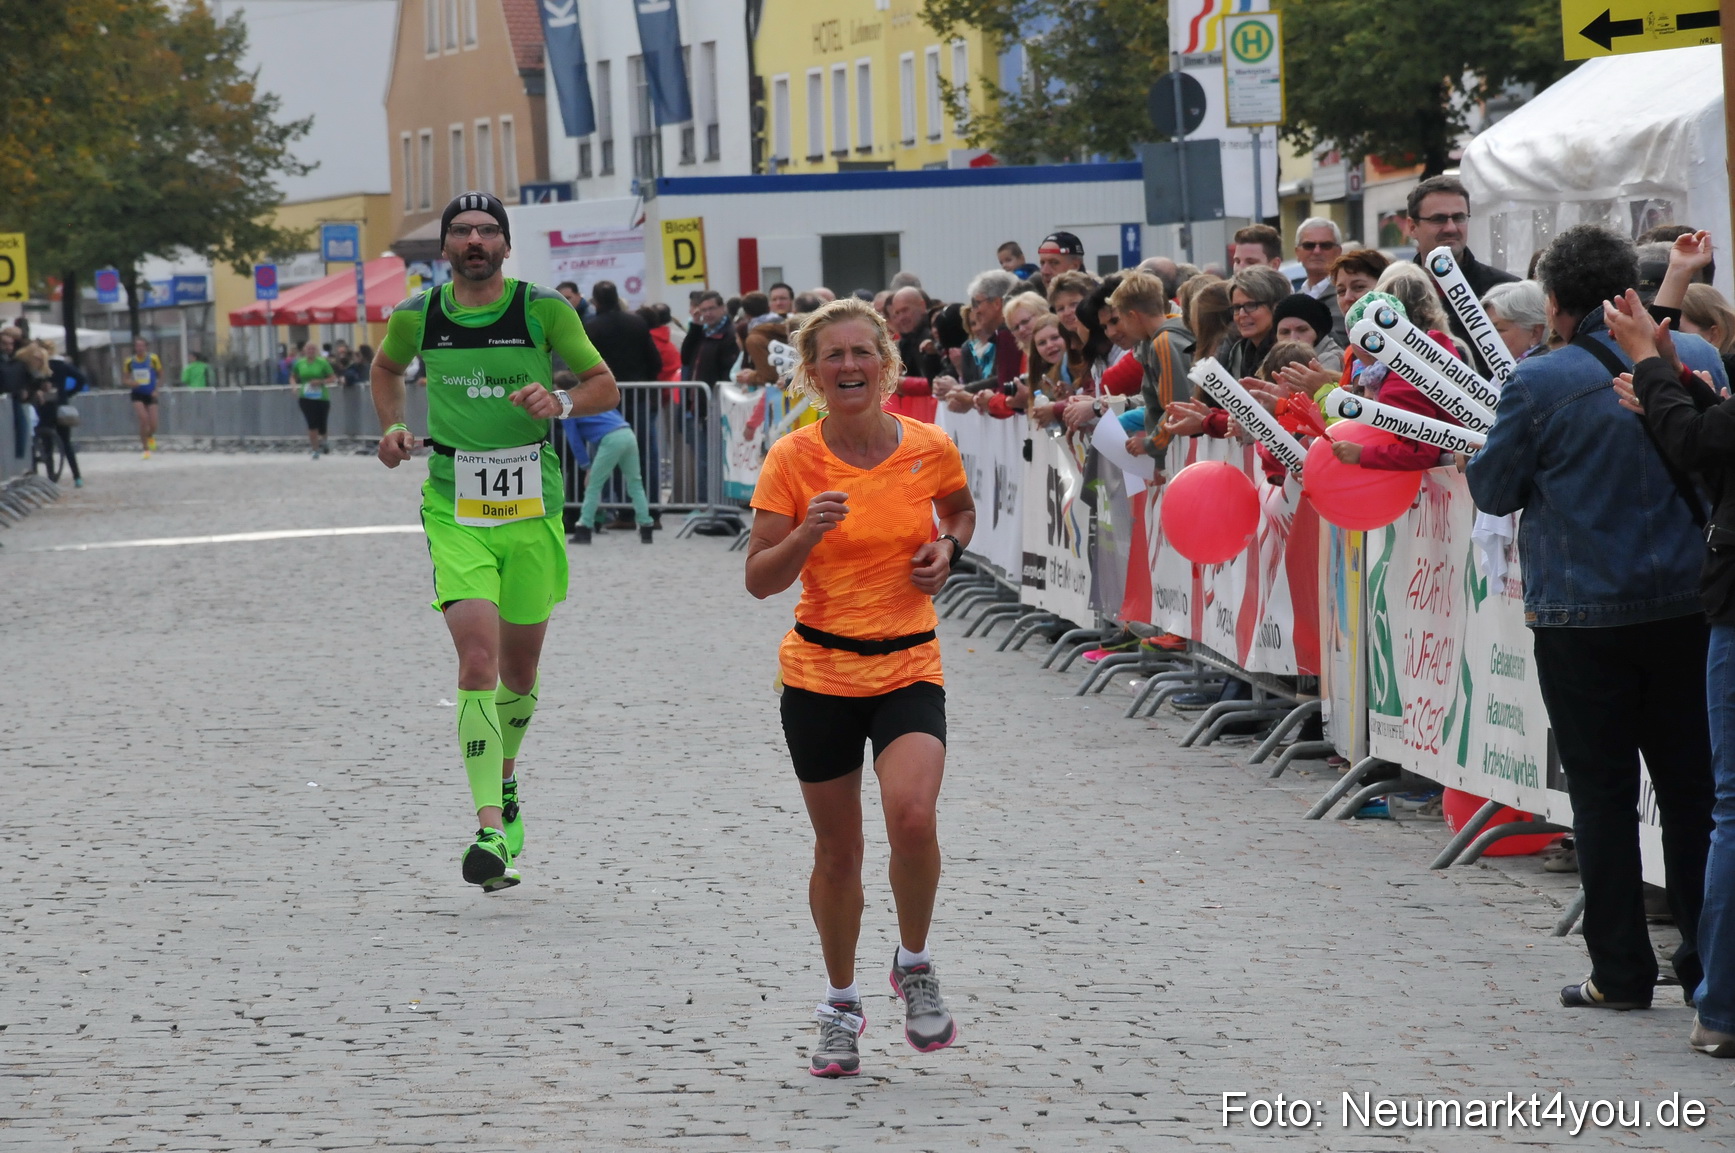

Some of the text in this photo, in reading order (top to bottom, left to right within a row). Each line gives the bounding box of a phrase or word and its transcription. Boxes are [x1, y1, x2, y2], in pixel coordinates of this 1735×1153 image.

[1241, 30, 1263, 55] H
[665, 221, 699, 234] Block
[673, 238, 696, 271] D
[1447, 282, 1511, 388] BMW Laufs
[442, 375, 479, 386] SoWiso
[1205, 372, 1303, 473] bmw-laufsport.de
[1372, 408, 1482, 455] bmw-laufspo
[457, 454, 528, 465] PARTL Neumarkt
[474, 466, 523, 497] 141
[482, 503, 518, 517] Daniel
